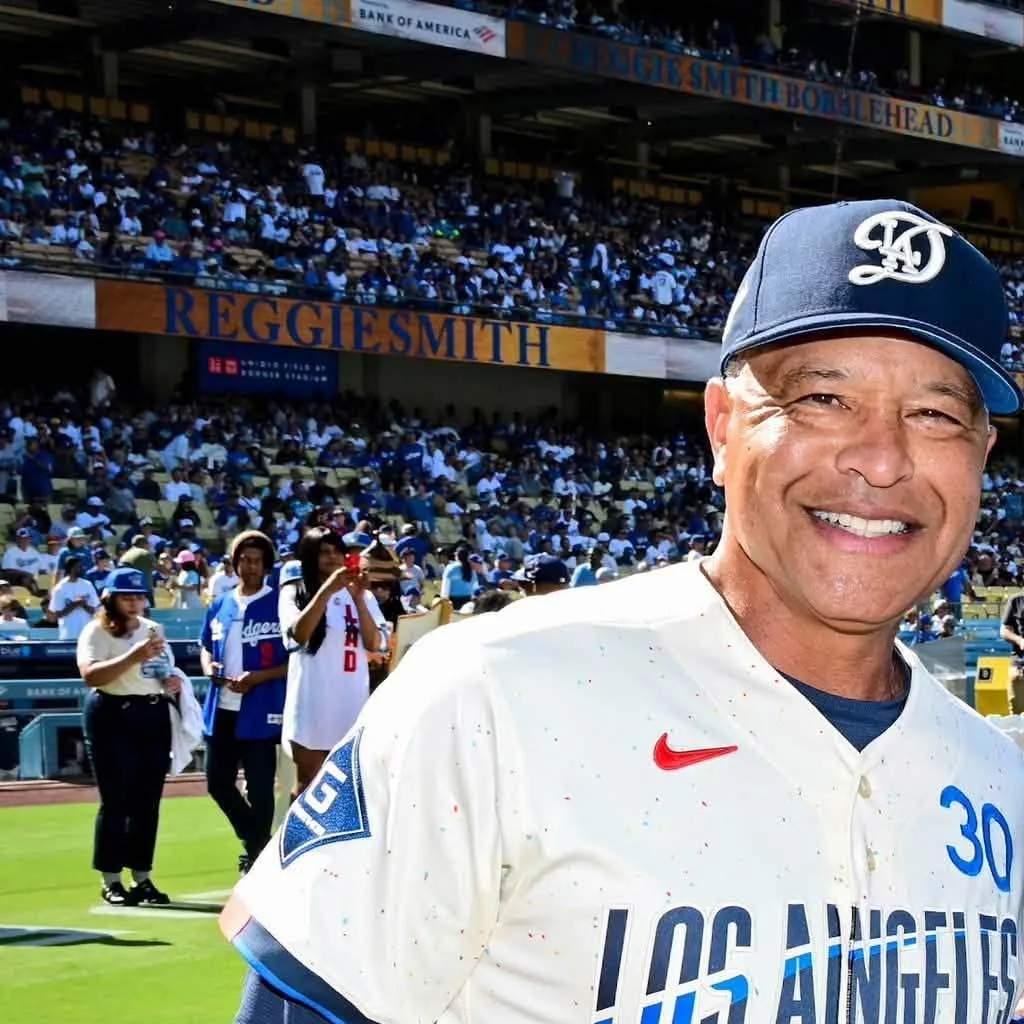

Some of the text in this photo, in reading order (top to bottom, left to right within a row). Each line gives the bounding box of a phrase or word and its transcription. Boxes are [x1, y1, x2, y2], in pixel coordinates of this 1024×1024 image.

[359, 8, 471, 40] BANK OF AMERICA
[164, 287, 552, 367] REGGIE SMITH
[940, 785, 1013, 892] 30
